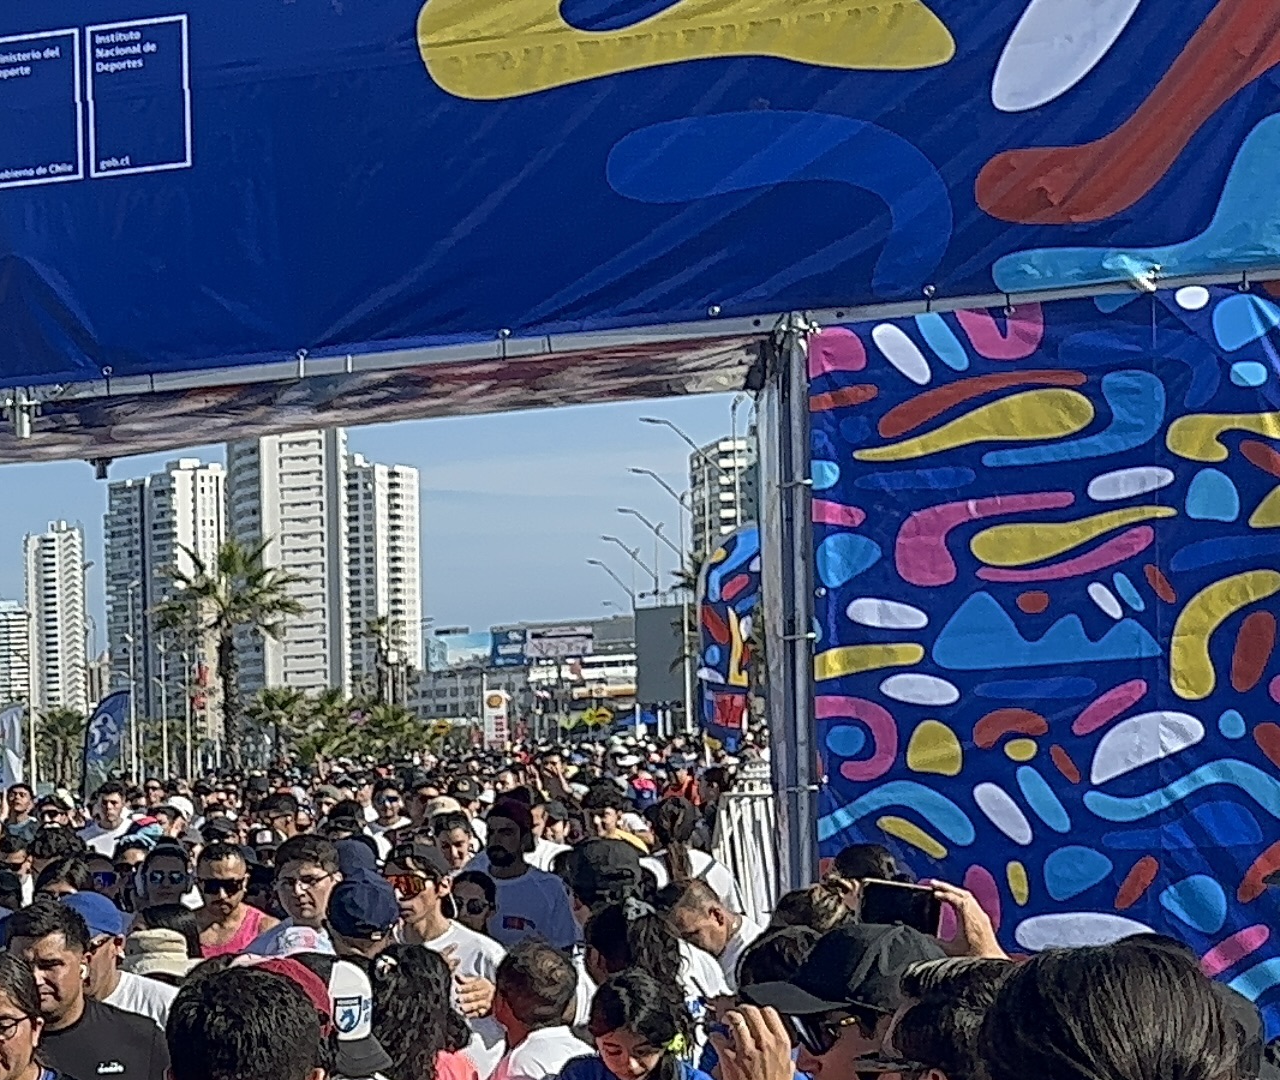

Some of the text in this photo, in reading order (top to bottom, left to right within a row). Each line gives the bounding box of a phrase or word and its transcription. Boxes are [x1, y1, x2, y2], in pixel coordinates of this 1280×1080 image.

[95, 30, 141, 44] Instituto
[43, 46, 60, 59] del
[95, 41, 157, 58] Nacional de
[95, 57, 143, 73] Deportes
[37, 166, 48, 176] de
[49, 162, 74, 175] Chile
